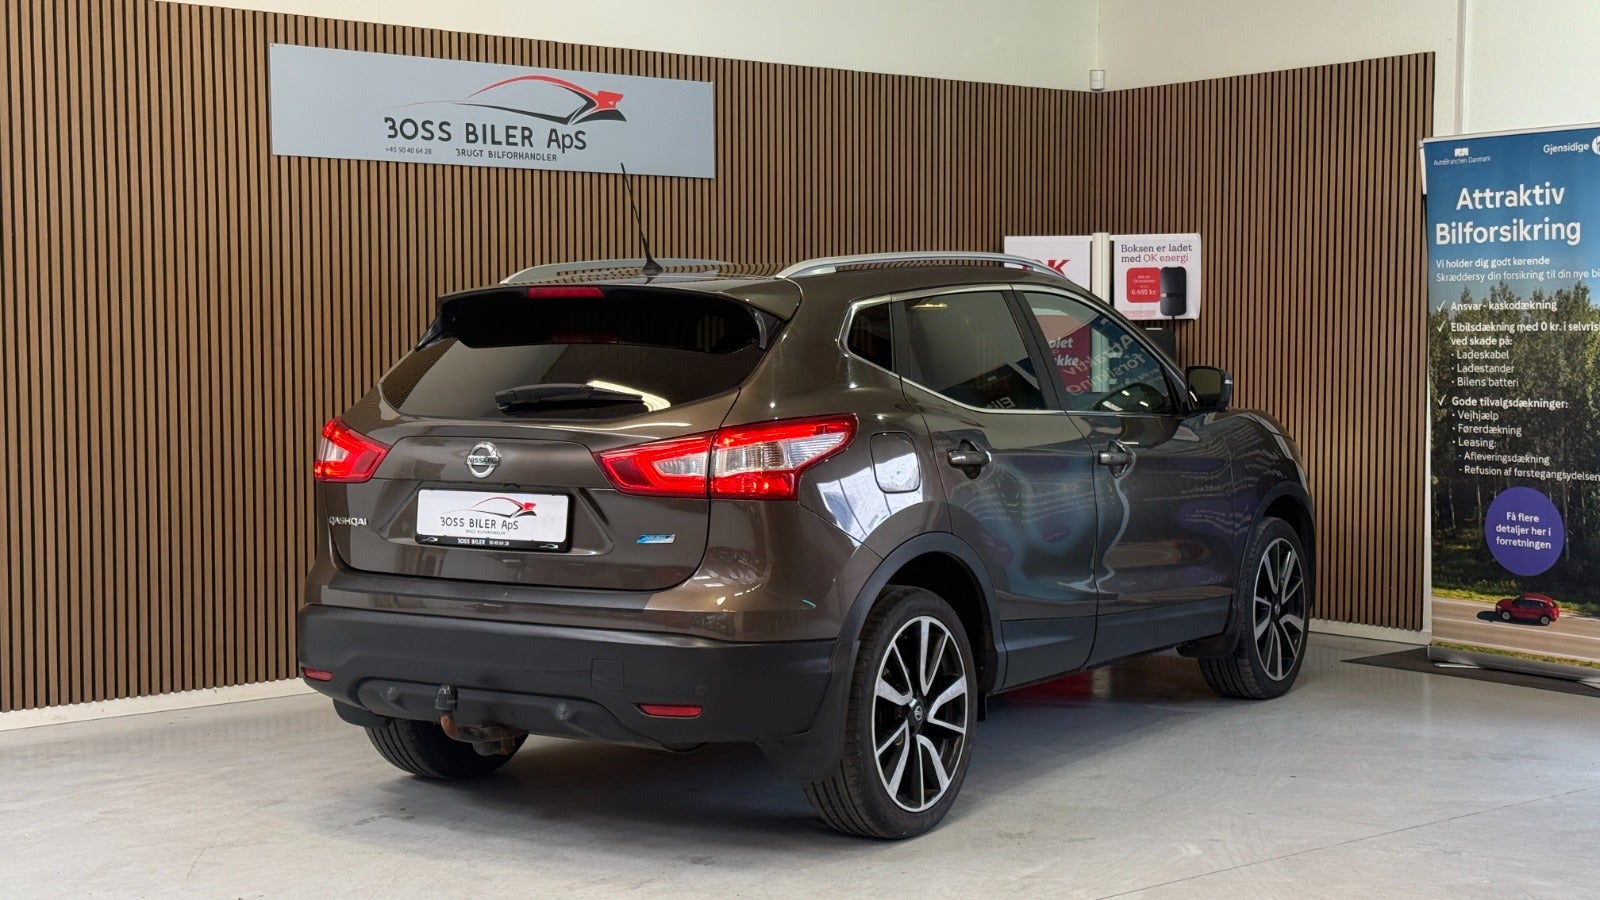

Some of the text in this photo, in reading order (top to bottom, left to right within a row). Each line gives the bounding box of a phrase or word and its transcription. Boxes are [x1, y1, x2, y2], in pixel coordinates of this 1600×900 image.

[465, 122, 534, 148] BILER
[546, 128, 587, 154] ApS
[1543, 142, 1590, 155] Gjensidige
[488, 150, 558, 161] BILFORHANDLER
[1455, 181, 1565, 211] Attraktiv
[1435, 216, 1581, 246] Bilforsikring
[1121, 244, 1154, 253] Boksen
[1168, 243, 1192, 252] ladet
[1121, 253, 1189, 264] med OK energi
[1435, 255, 1550, 269] Vi holder dig godt kørende
[1436, 272, 1486, 283] Skræddersy
[1487, 271, 1502, 280] din
[1503, 270, 1545, 281] forsikring
[1546, 269, 1556, 279] til
[1557, 268, 1571, 279] din
[1573, 270, 1589, 280] nye
[1451, 299, 1557, 312] Ansvar- kaskodækning
[1450, 321, 1516, 334] Elbilsdækning
[1516, 321, 1538, 332] med
[1540, 321, 1547, 331] 0
[1549, 321, 1562, 332] kr.
[1450, 335, 1513, 347] ved skade på:
[1456, 349, 1510, 360] Ladeskabel
[1456, 363, 1515, 373] Ladestander
[1457, 376, 1519, 388] Bilens batteri
[1451, 396, 1569, 411] Gode tilvalgsdækninger:
[1457, 410, 1499, 422] Vejhjælp
[1457, 423, 1522, 437] Førerdækning
[1458, 437, 1497, 449] Leasing:
[1463, 451, 1550, 466] Afleveringsdækning
[1464, 465, 1502, 476] Refusion
[1503, 467, 1512, 476] af
[1506, 511, 1540, 523] Få flere
[469, 518, 496, 529] BILER
[501, 520, 519, 531] ApS
[1495, 523, 1530, 536] detaljer
[1531, 526, 1547, 536] her
[1495, 536, 1552, 550] forretningen
